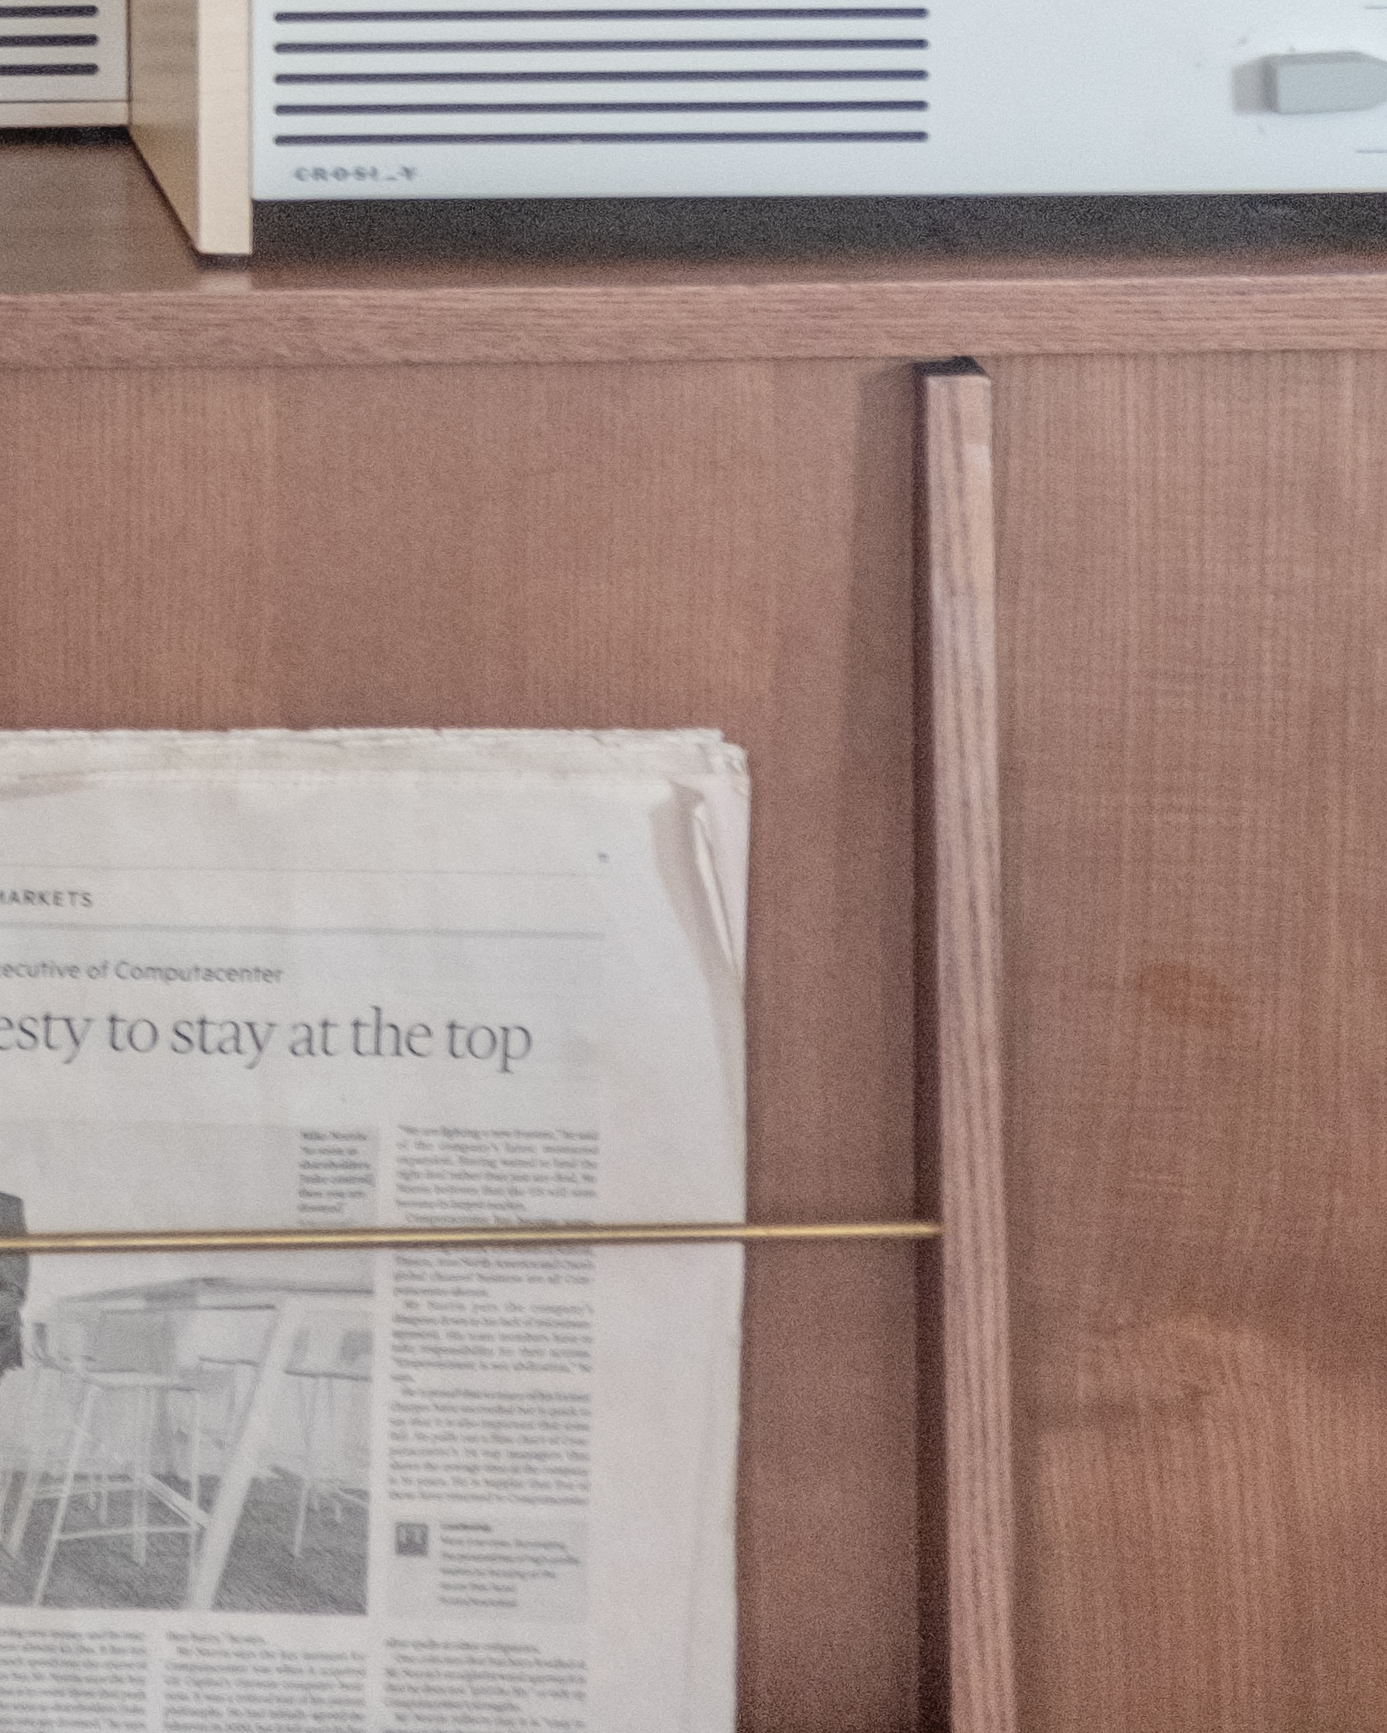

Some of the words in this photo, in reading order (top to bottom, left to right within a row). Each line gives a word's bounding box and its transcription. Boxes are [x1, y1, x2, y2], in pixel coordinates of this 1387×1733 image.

[86, 959, 109, 980] of
[114, 961, 283, 983] Computacenter
[107, 1013, 159, 1053] to
[170, 1013, 278, 1070] stay
[288, 1017, 339, 1057] at
[350, 1004, 433, 1058] the
[445, 1019, 533, 1074] top
